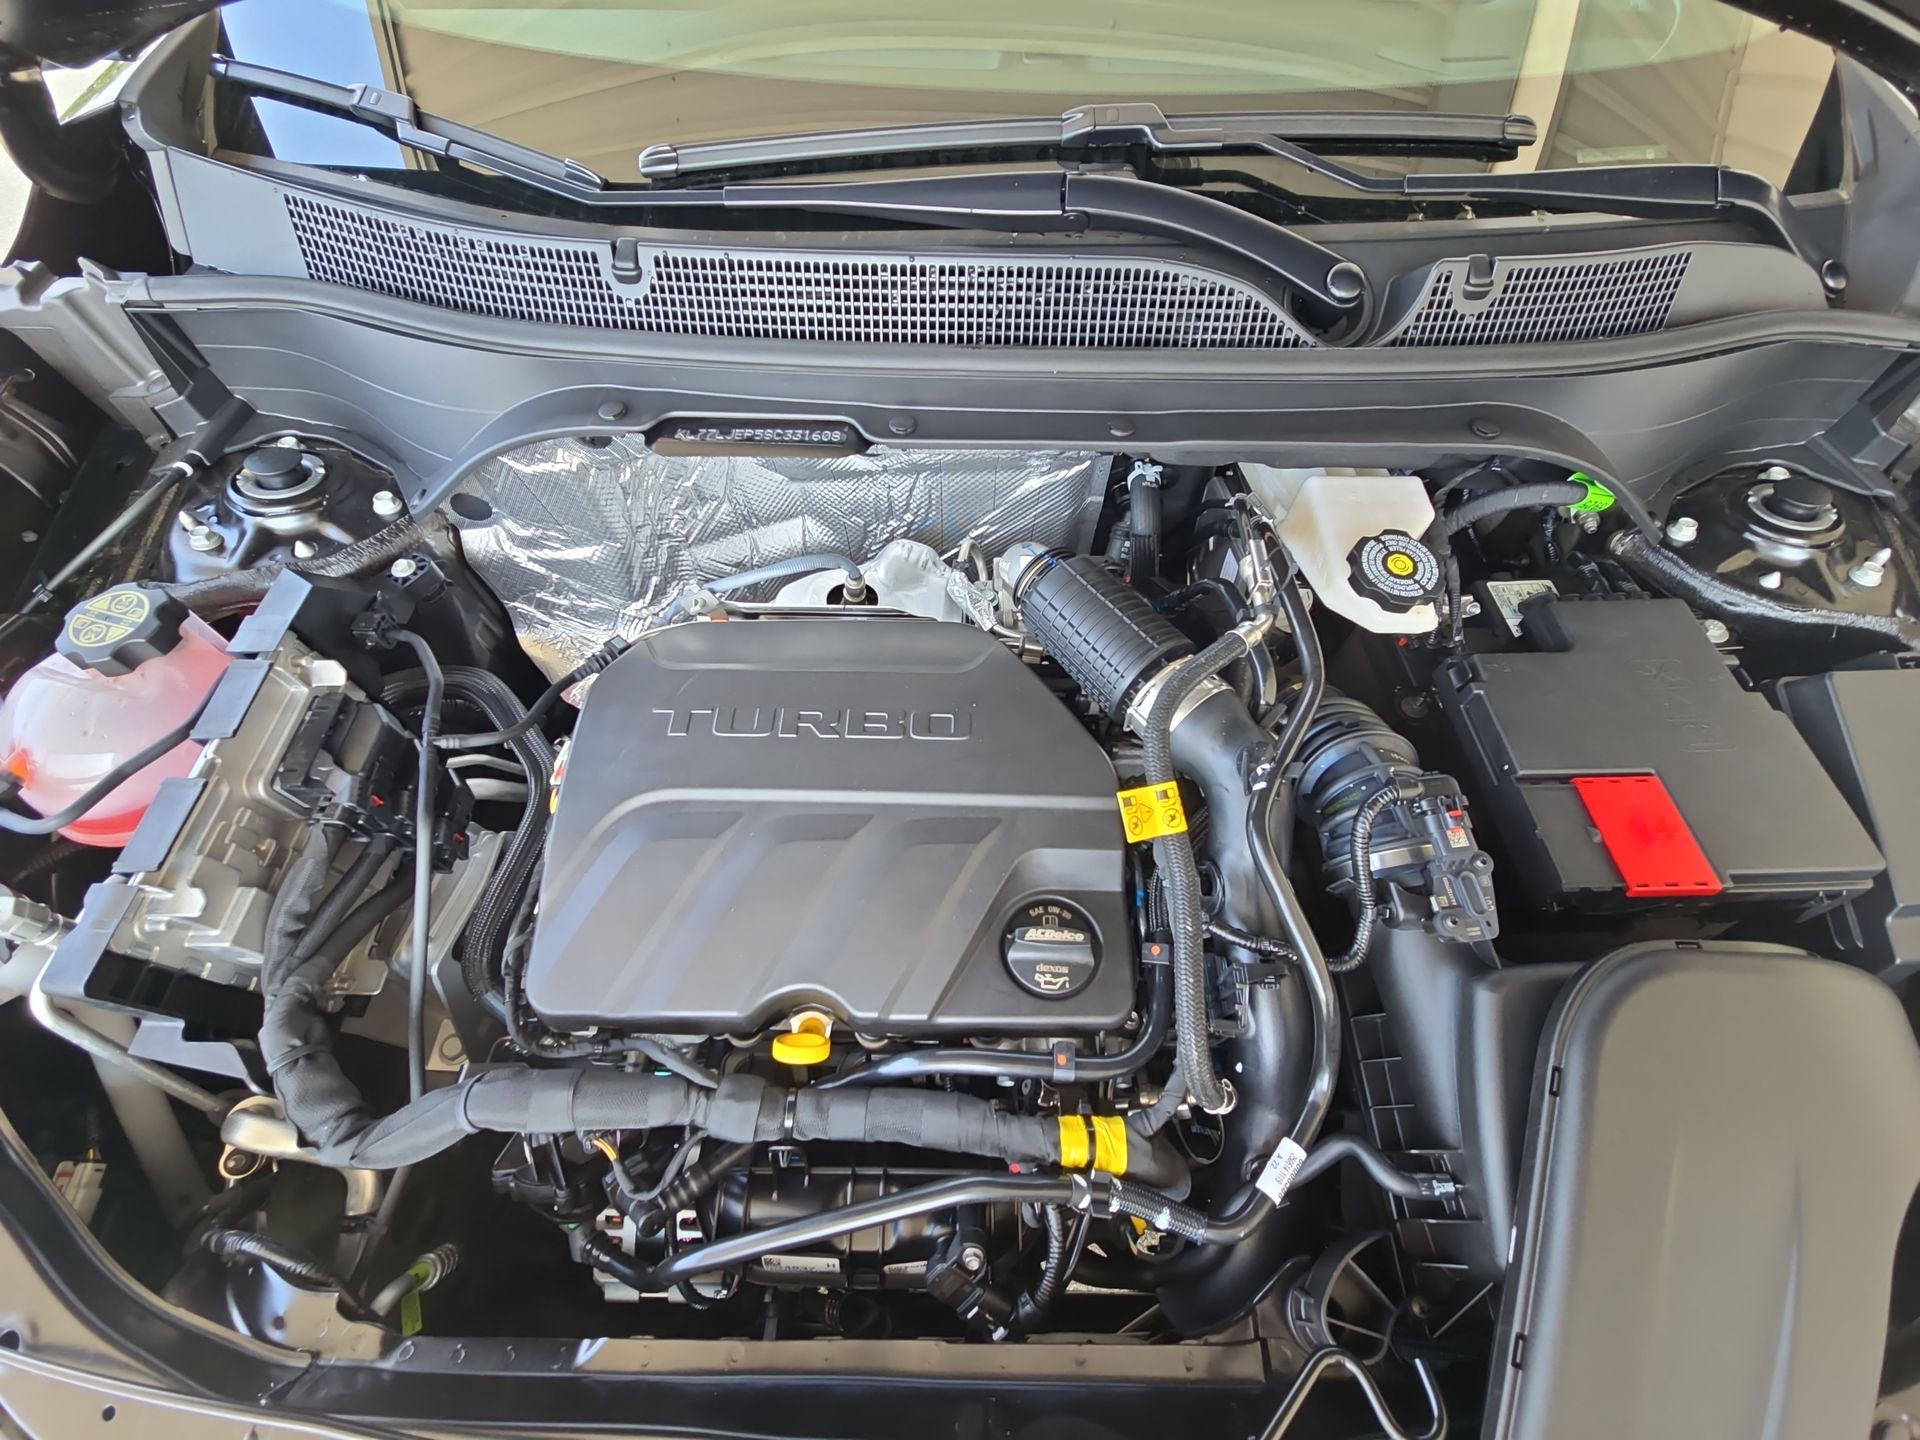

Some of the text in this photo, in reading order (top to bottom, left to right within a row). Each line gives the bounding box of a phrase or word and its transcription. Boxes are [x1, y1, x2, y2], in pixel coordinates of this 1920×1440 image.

[674, 428, 841, 442] KL77LJEP5SC331608
[652, 707, 972, 740] TURBO
[1029, 906, 1072, 920] SAE 0W-20
[1024, 928, 1085, 942] ACDelco
[1036, 963, 1069, 974] dexos
